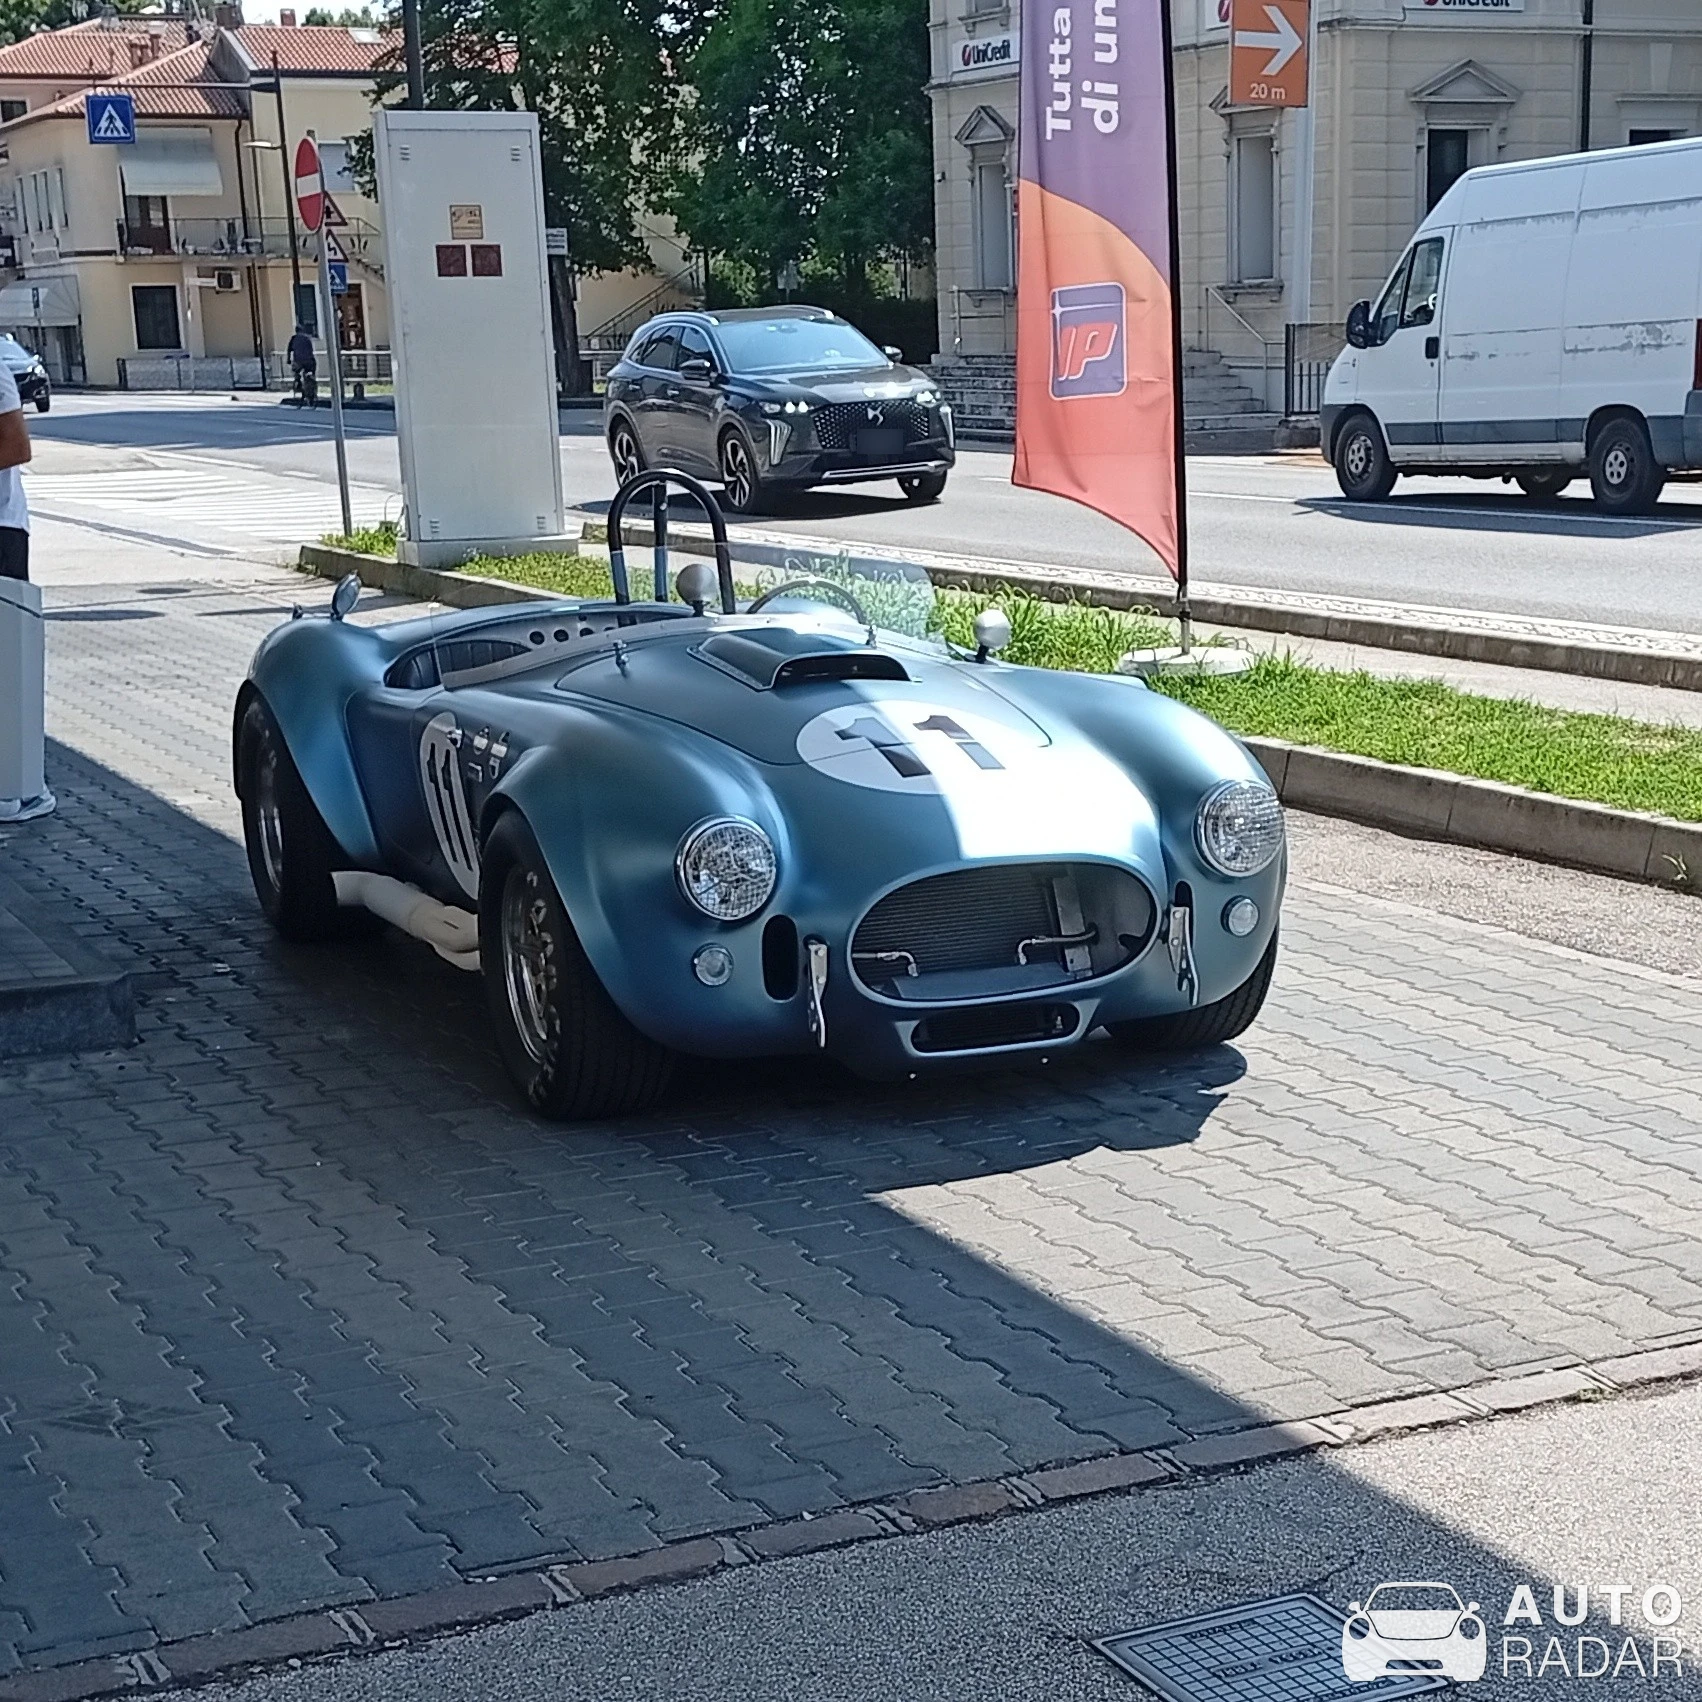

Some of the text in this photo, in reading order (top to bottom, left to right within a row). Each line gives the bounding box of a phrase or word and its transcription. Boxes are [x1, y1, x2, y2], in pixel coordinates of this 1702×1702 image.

[972, 39, 1011, 64] UniCredit
[1045, 8, 1071, 140] Tutta
[1081, 80, 1119, 134] di
[1250, 83, 1286, 100] 20 m
[834, 714, 1006, 778] 11
[427, 742, 474, 872] 11
